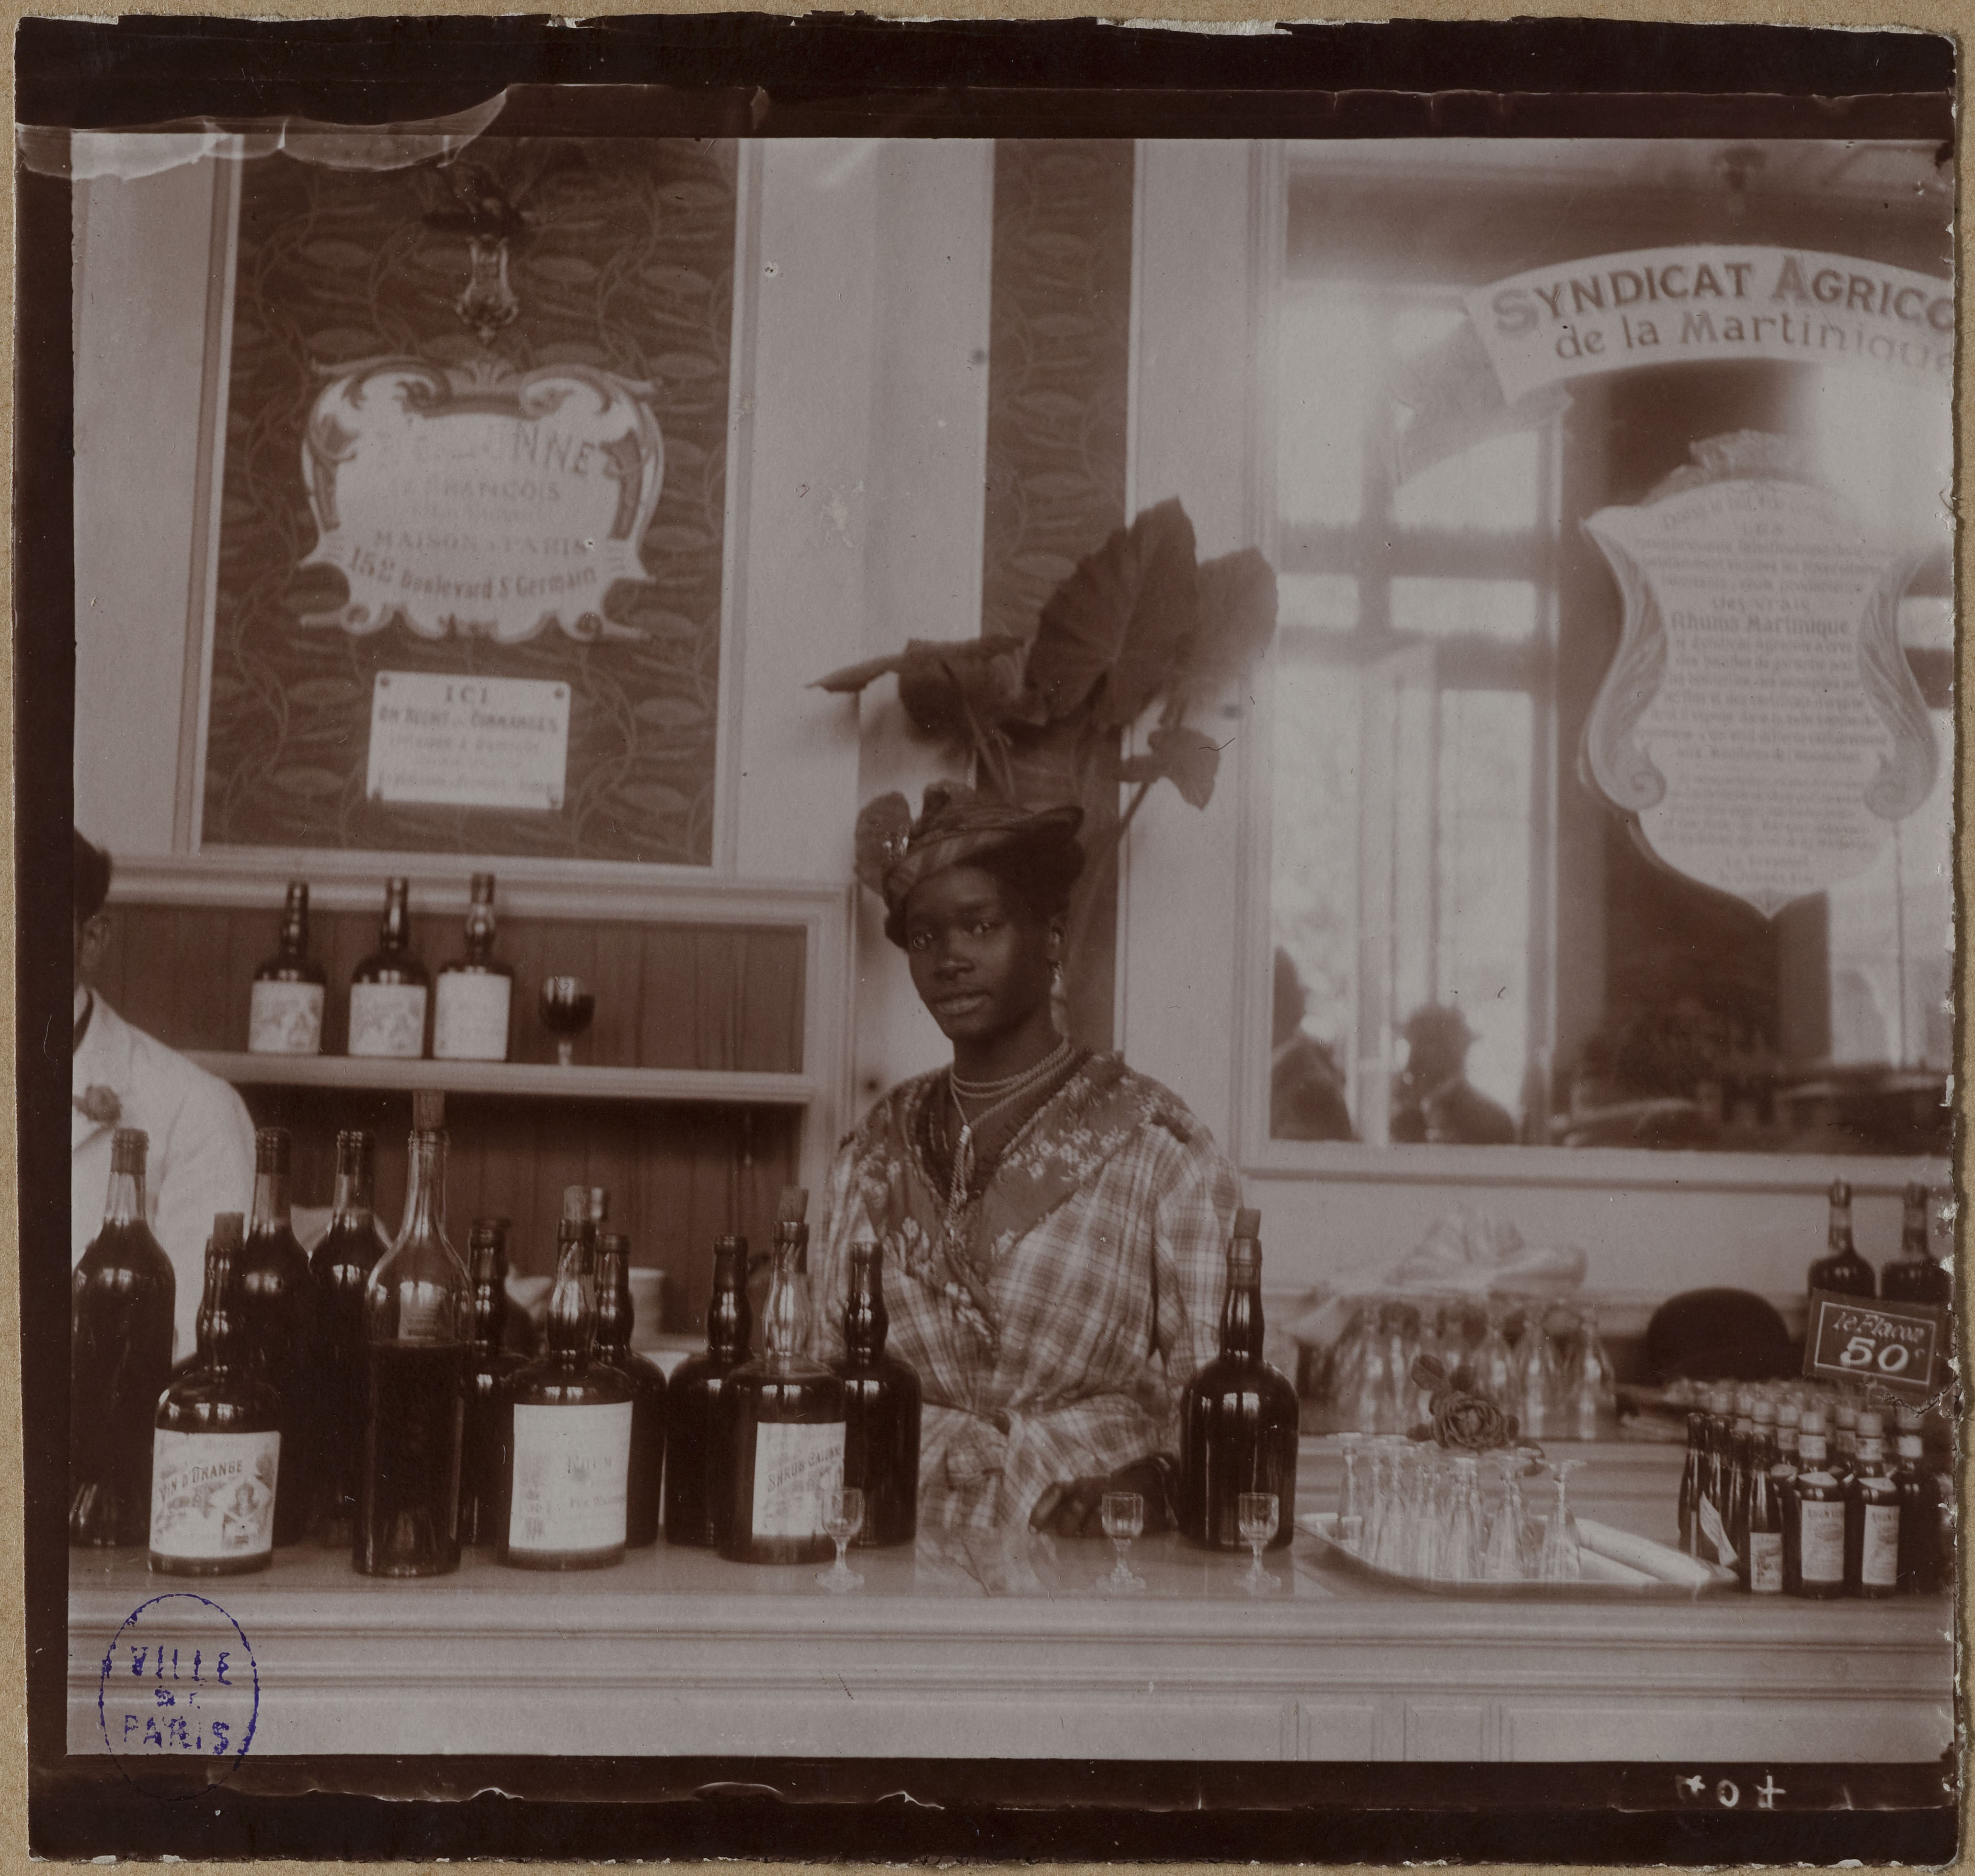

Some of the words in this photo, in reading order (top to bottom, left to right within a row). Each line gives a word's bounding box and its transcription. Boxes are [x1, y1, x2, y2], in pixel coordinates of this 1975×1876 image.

[1490, 262, 1755, 333] SYNDICAT
[1555, 324, 1607, 361] de
[1622, 317, 1660, 350] la
